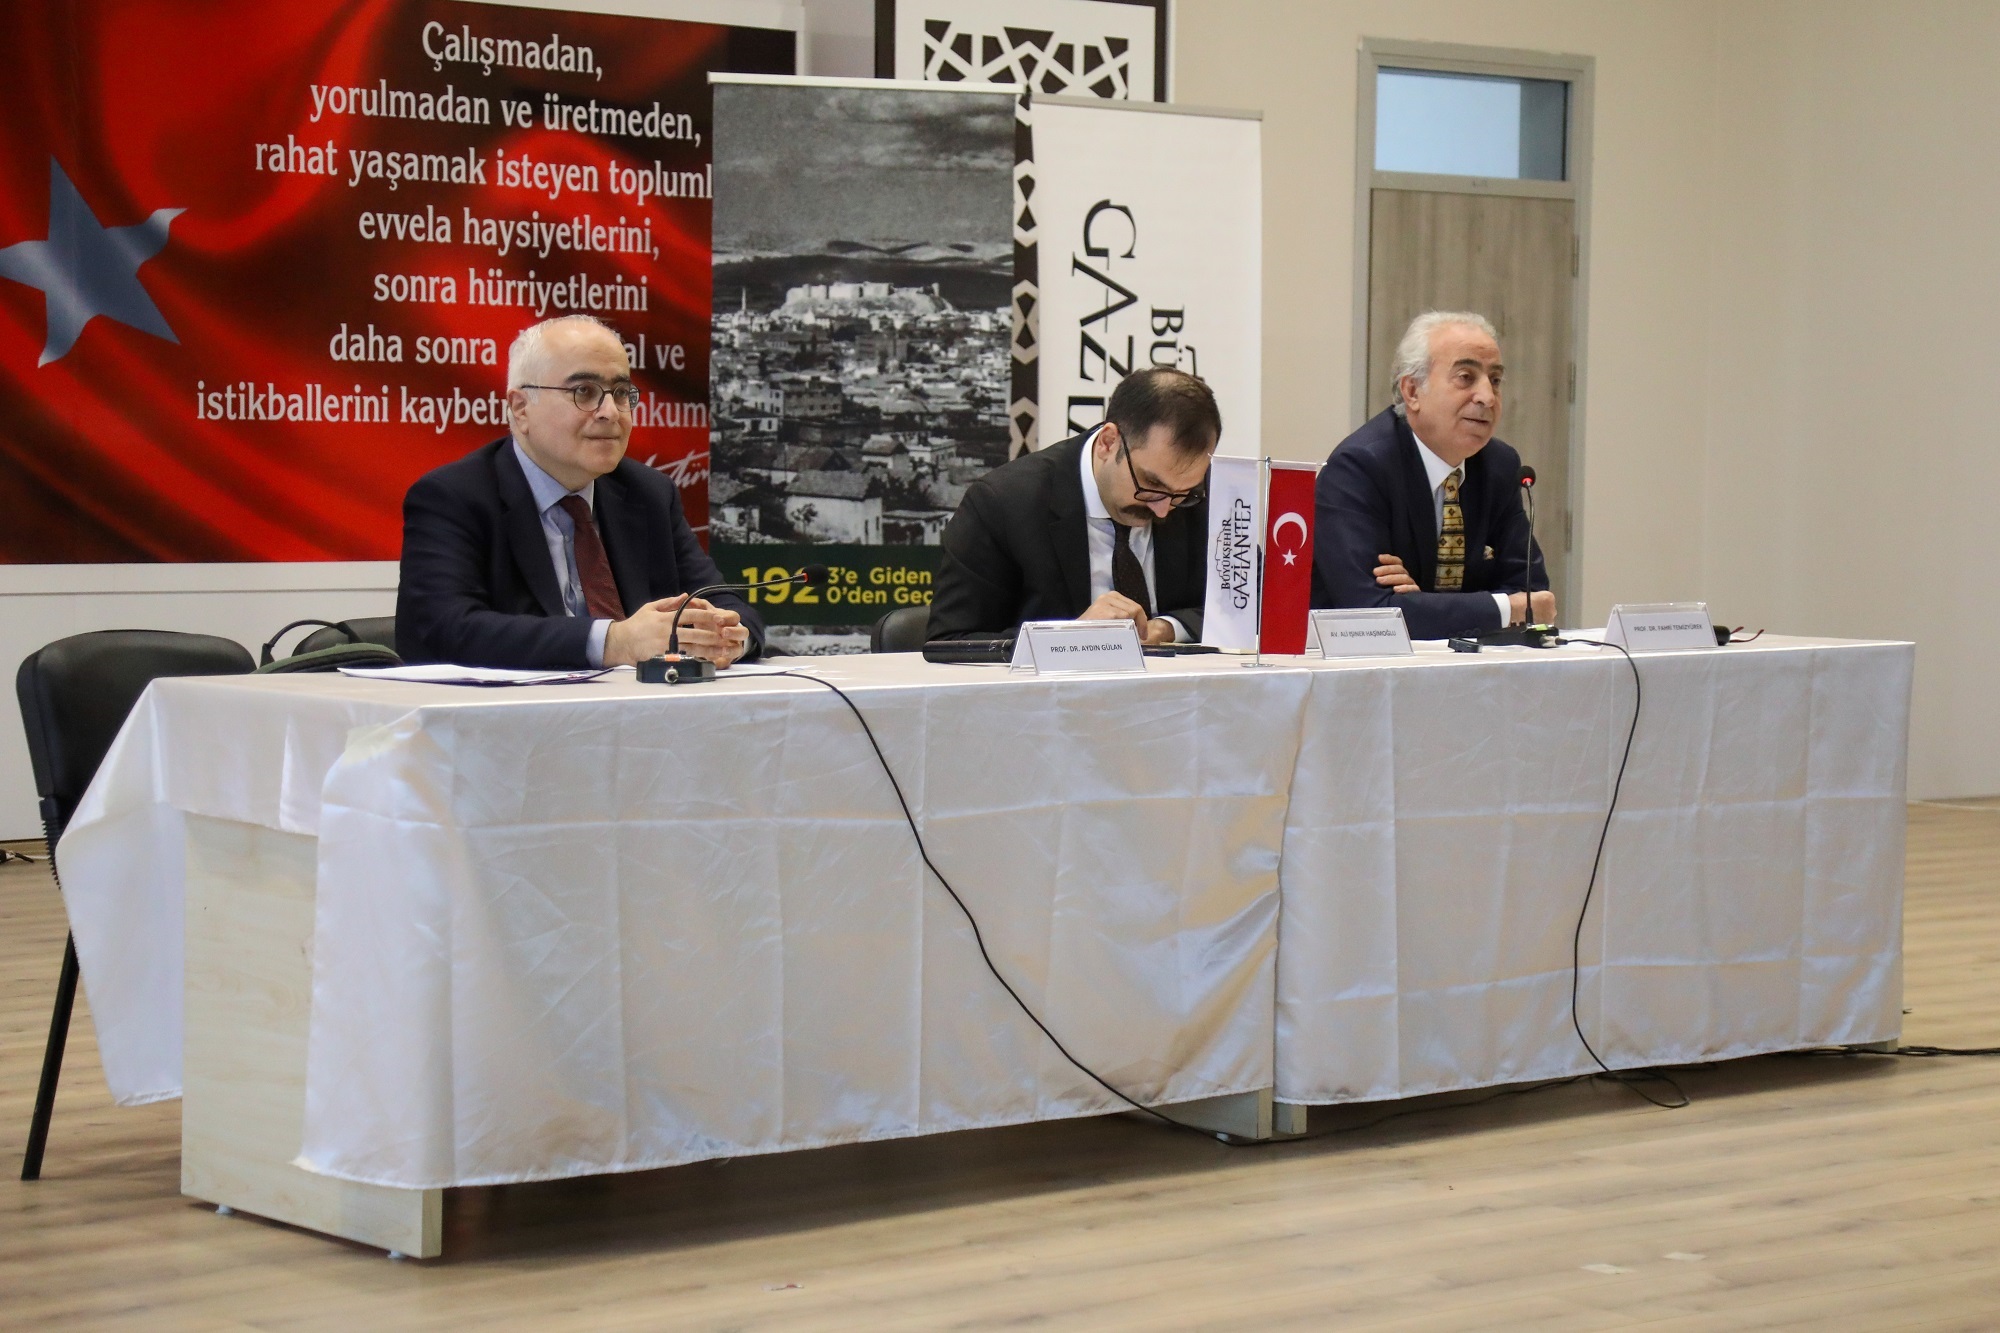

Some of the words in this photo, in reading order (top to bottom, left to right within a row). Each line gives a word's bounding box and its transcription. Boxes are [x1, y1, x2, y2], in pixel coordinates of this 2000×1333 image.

[422, 21, 603, 81] Çalışmadan,
[310, 79, 491, 124] yorulmadan
[500, 99, 533, 129] ve
[544, 93, 701, 147] üretmeden,
[255, 135, 338, 176] rahat
[348, 147, 487, 191] yaşamak
[496, 149, 599, 200] isteyen
[359, 205, 452, 243] evvela
[463, 205, 660, 259] haysiyetlerini,
[373, 272, 457, 304] sonra
[468, 268, 648, 317] hürriyetlerini
[329, 323, 403, 362] daha
[415, 334, 497, 365] sonra
[655, 344, 686, 370] ve
[197, 381, 389, 422] istikballerini
[869, 567, 932, 585] Giden
[1231, 498, 1252, 609] GAZİANTEP
[1050, 645, 1069, 653] PROF.
[1081, 644, 1101, 652] AYDIN
